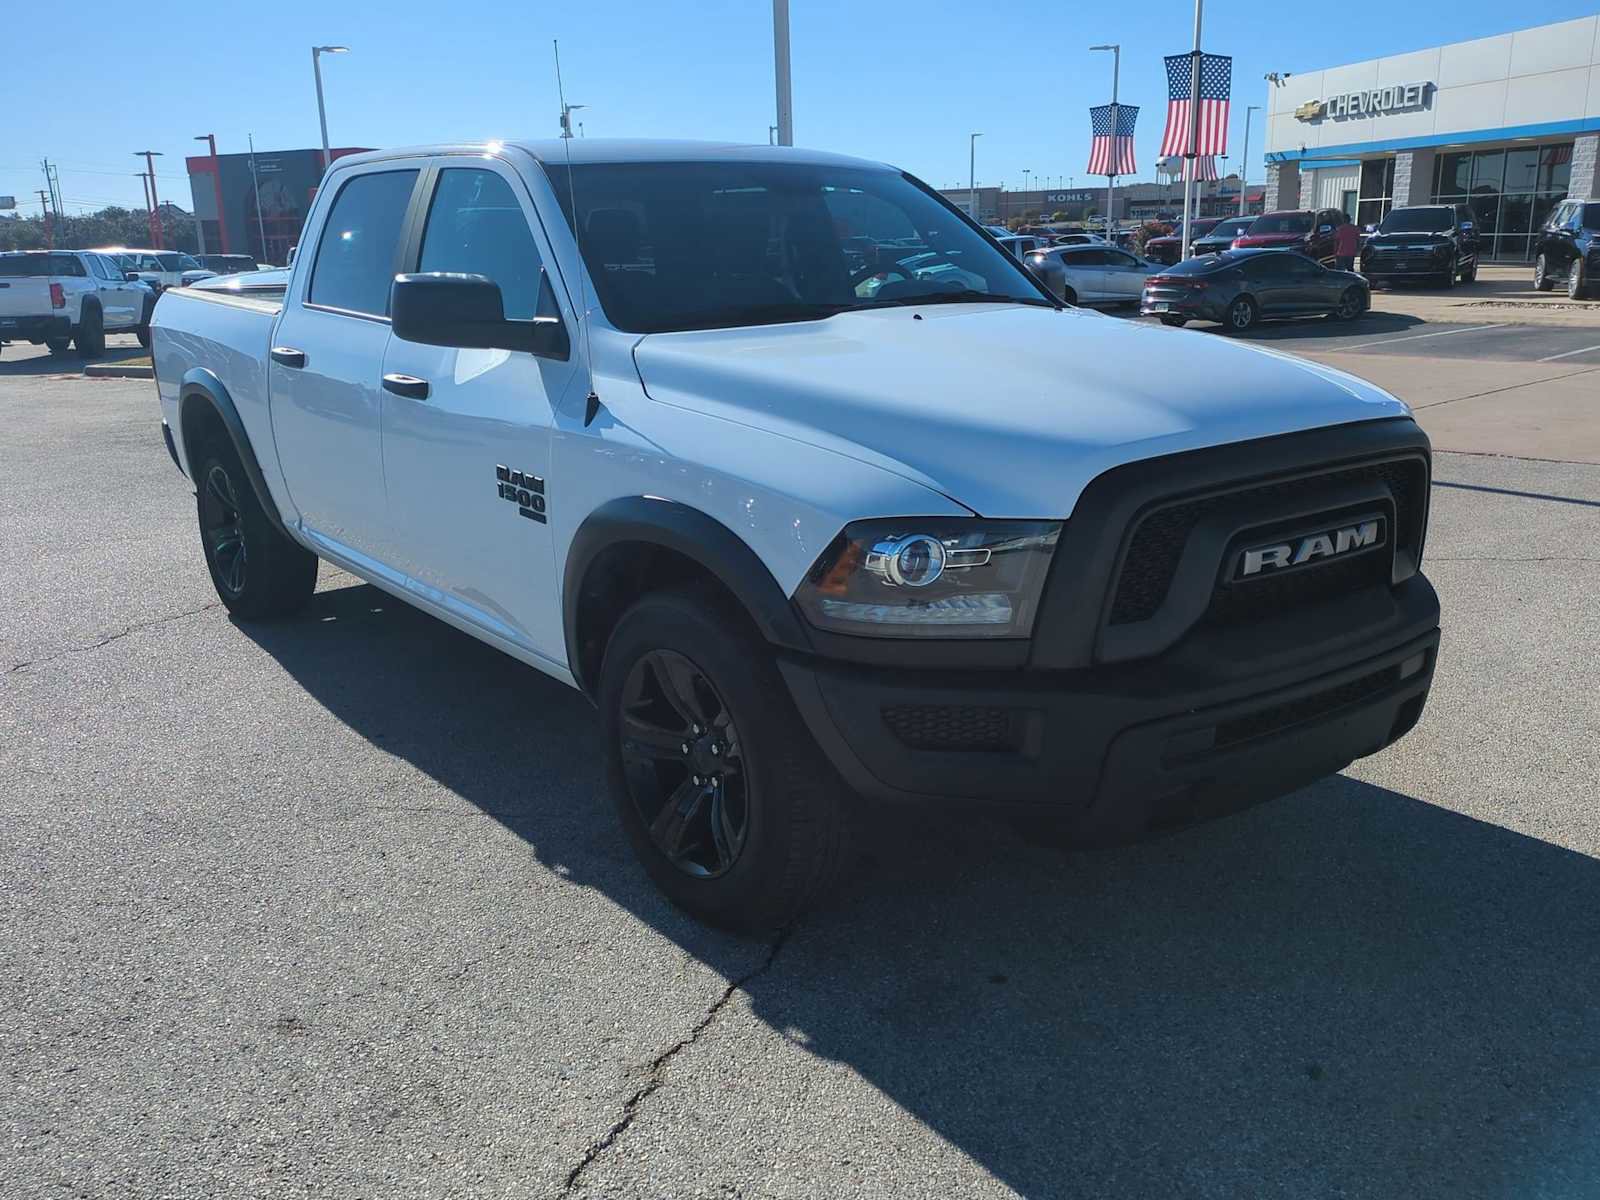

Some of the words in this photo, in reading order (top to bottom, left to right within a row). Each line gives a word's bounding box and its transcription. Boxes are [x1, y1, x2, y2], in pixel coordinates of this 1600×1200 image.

[1326, 82, 1430, 118] CHEVROLET
[1047, 192, 1092, 202] KOHL'S
[496, 463, 545, 495] RAM
[497, 481, 546, 513] 1500
[1243, 520, 1378, 576] RAM
